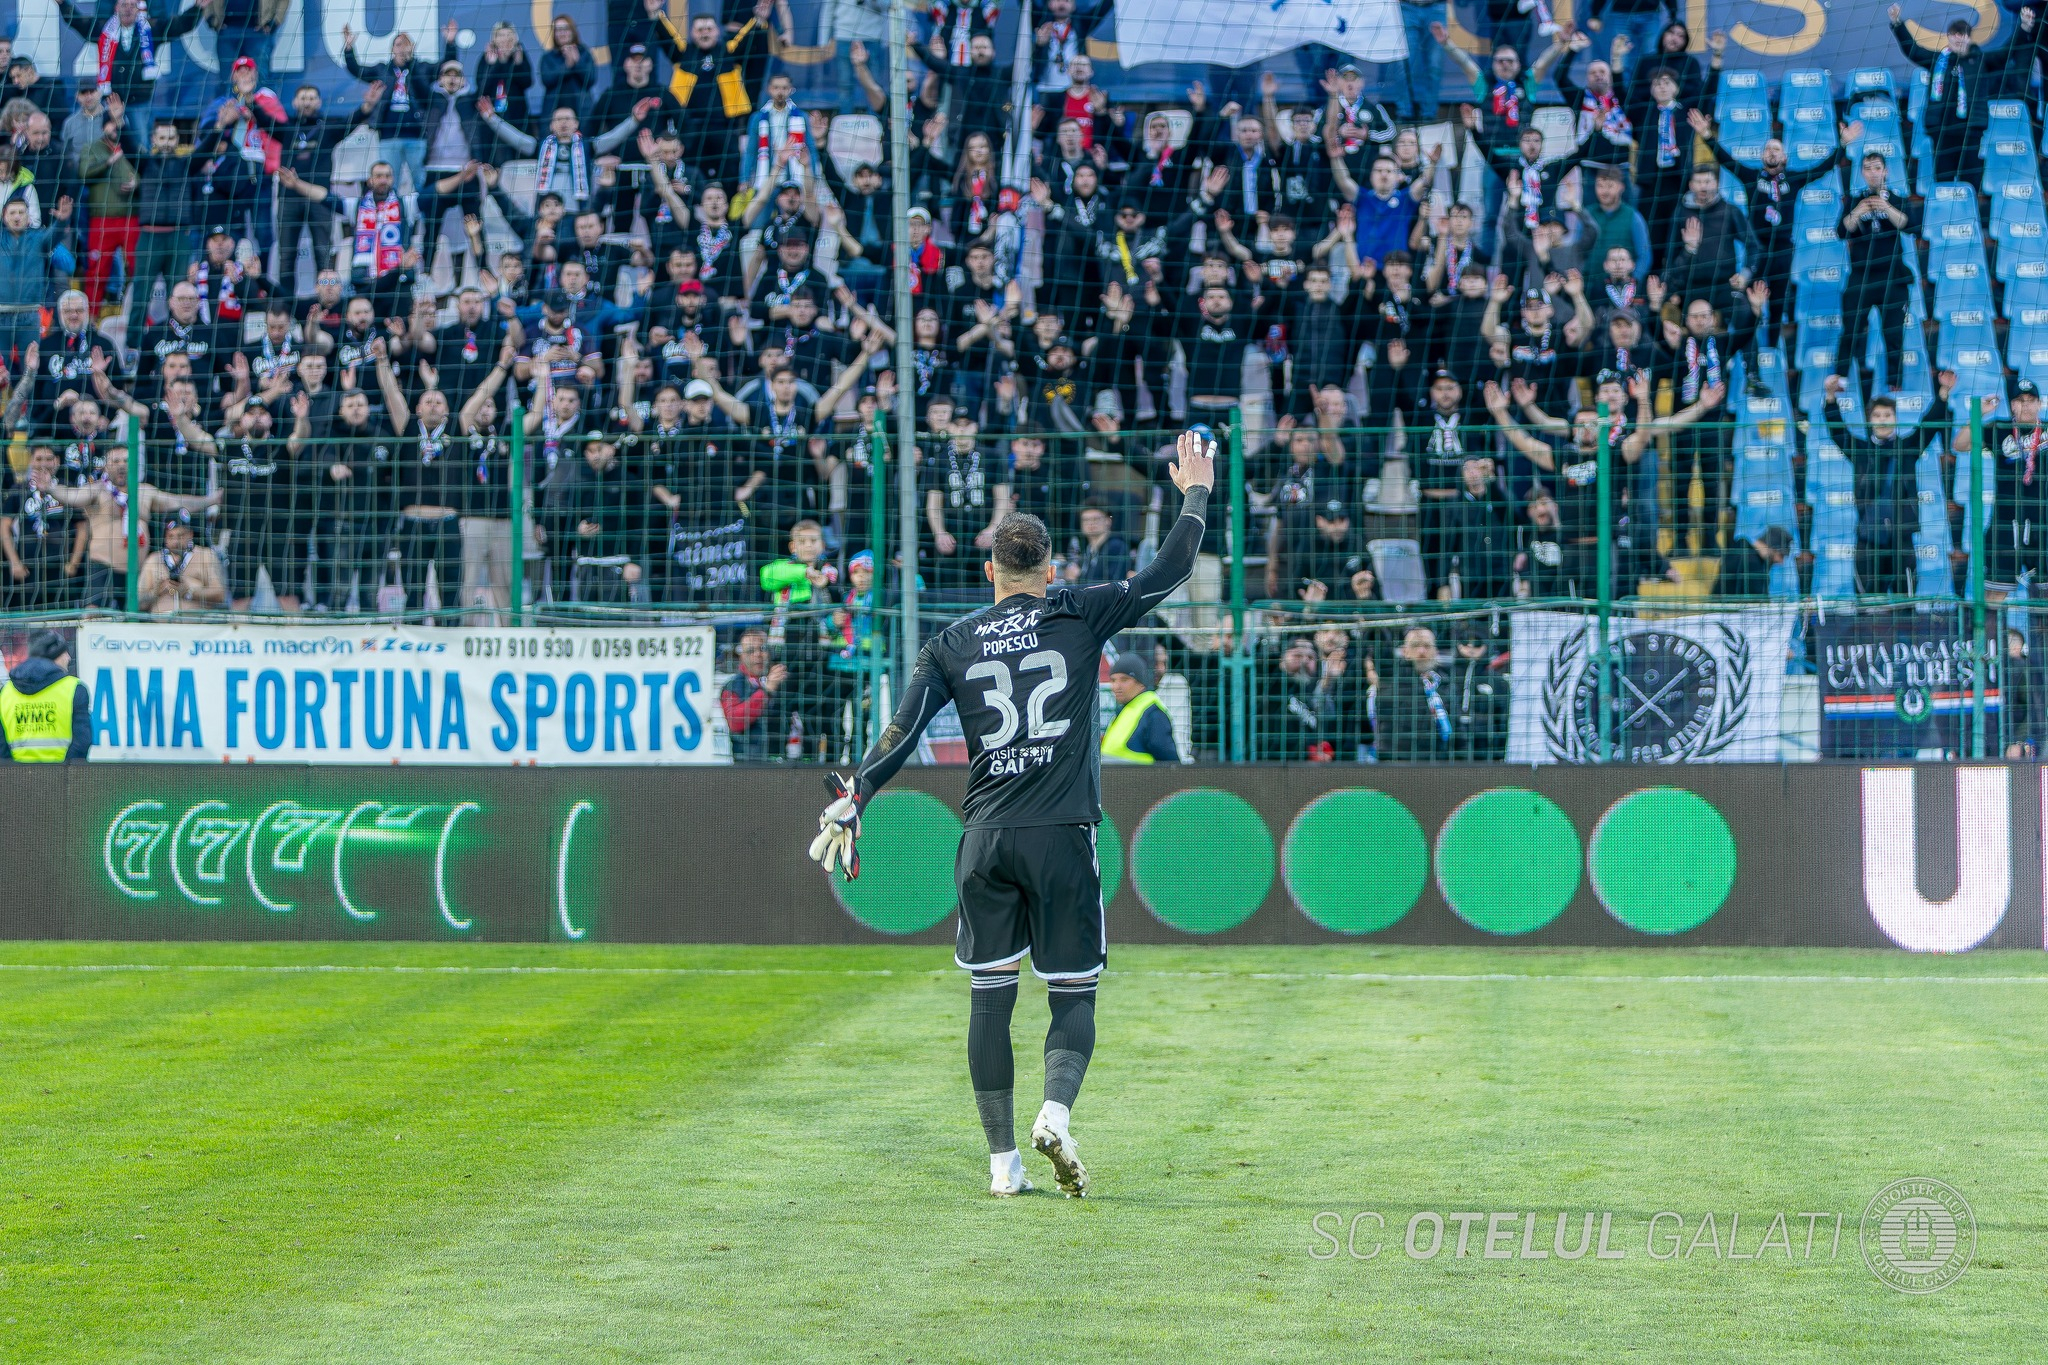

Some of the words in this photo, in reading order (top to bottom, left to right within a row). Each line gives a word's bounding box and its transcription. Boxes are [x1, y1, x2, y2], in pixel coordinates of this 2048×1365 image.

[105, 639, 181, 651] GIVOVA
[464, 636, 500, 658] 0737
[507, 637, 538, 658] 910
[544, 637, 574, 659] 930
[592, 637, 633, 659] 0759
[637, 637, 668, 658] 054
[673, 636, 705, 658] 922
[983, 632, 1039, 657] POPESCU
[225, 667, 470, 750] FORTUNA
[491, 670, 703, 752] SPORTS
[965, 650, 1071, 750] 32
[15, 709, 56, 724] WMC
[990, 746, 1018, 760] visit
